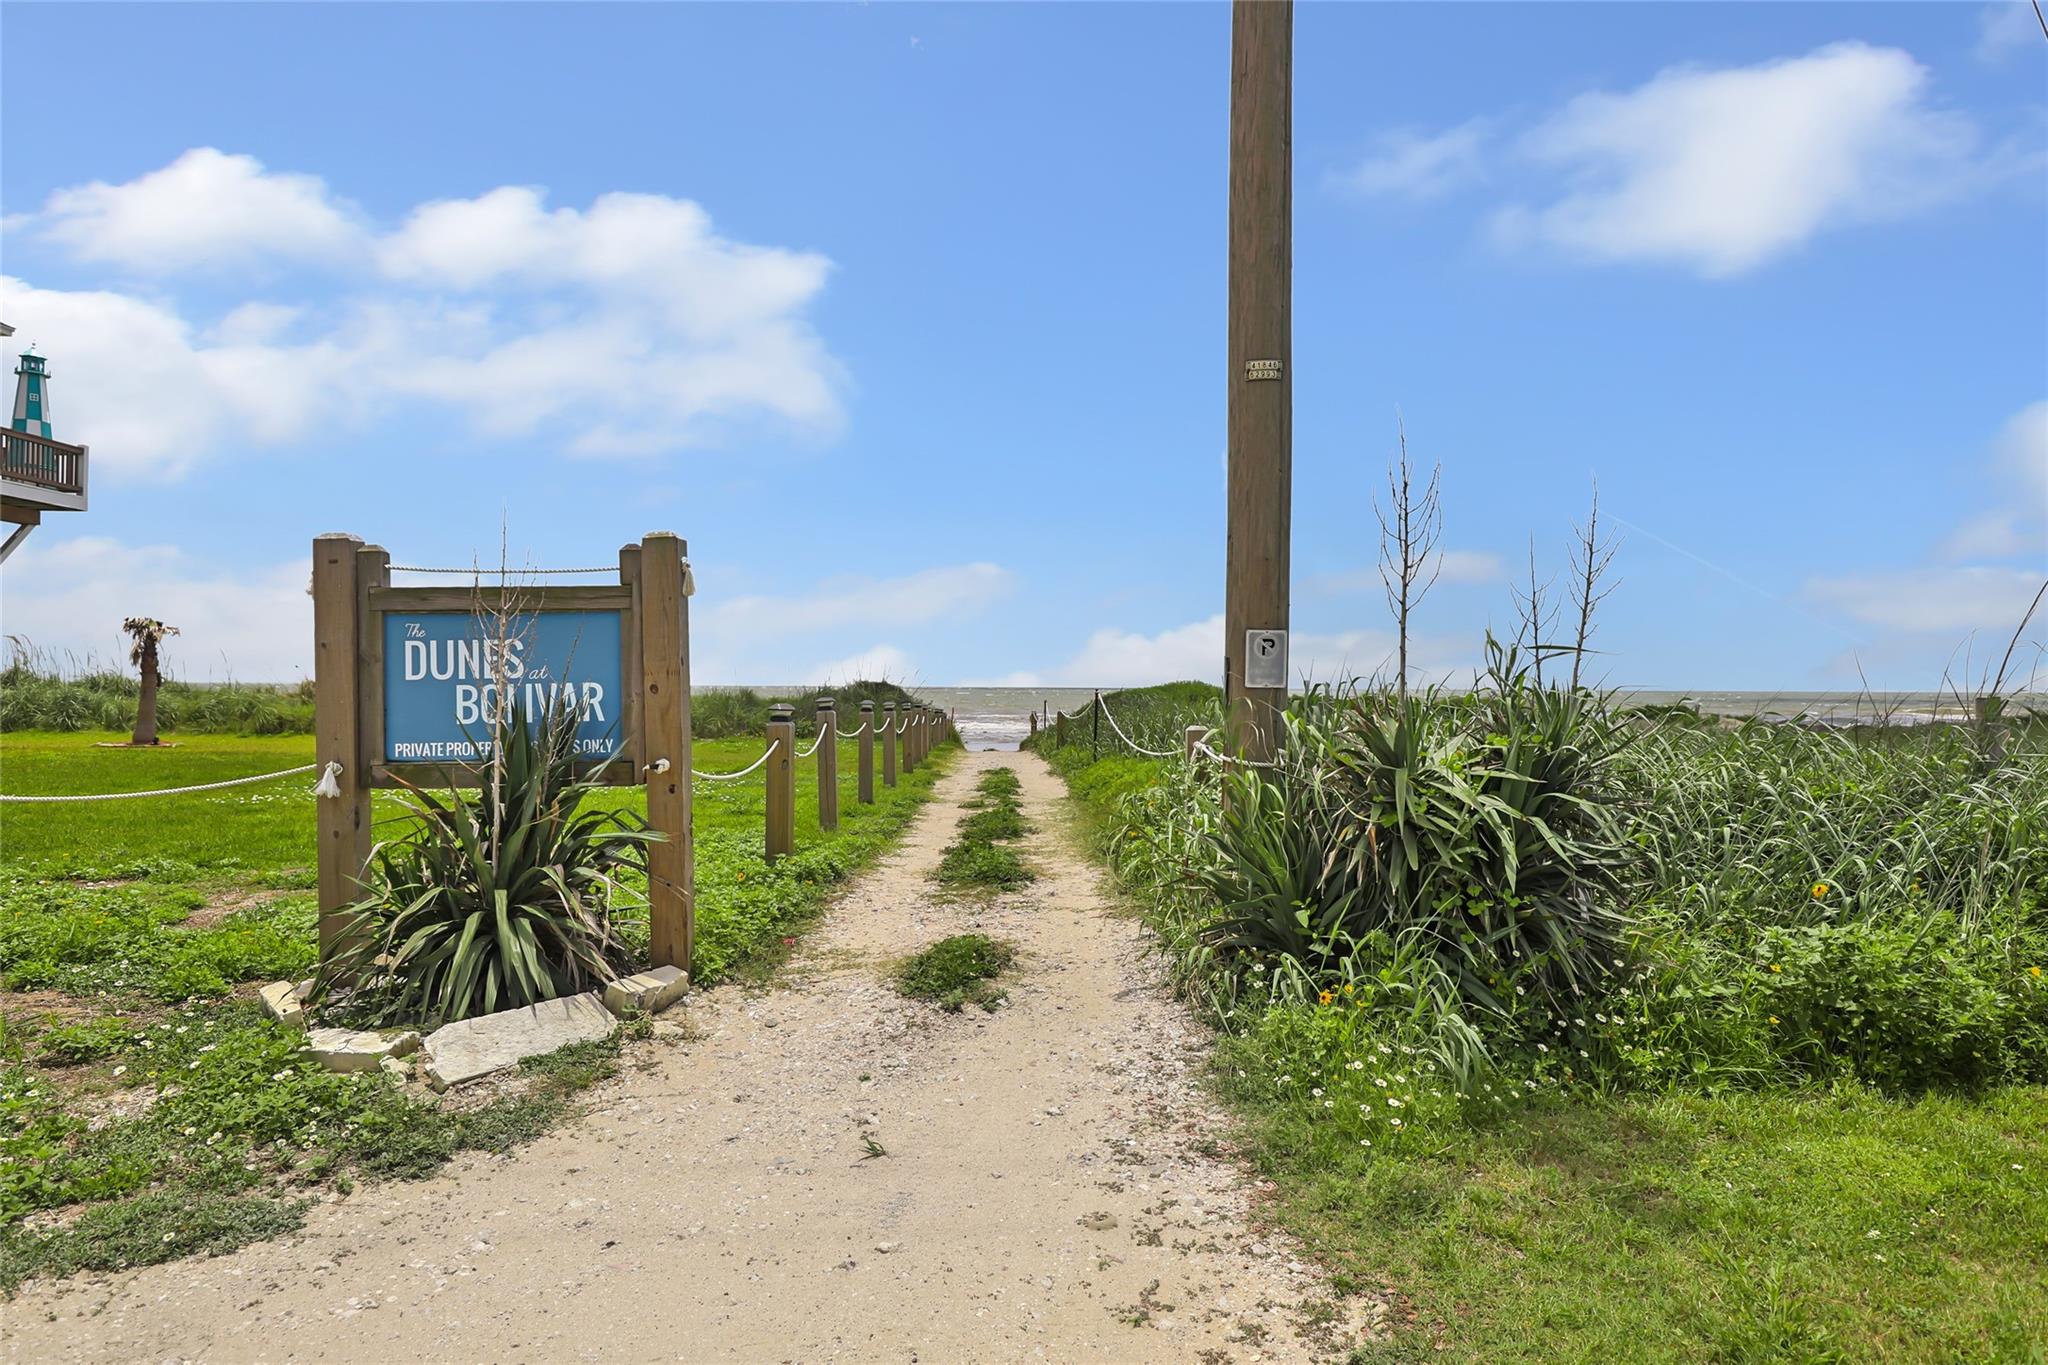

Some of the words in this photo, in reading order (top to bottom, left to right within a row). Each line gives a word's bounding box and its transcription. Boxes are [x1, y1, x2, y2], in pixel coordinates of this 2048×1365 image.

[405, 623, 426, 639] The
[405, 639, 524, 681] DUNES
[528, 664, 549, 680] at
[394, 742, 445, 757] PRIVATE
[582, 738, 614, 754] ONLY
